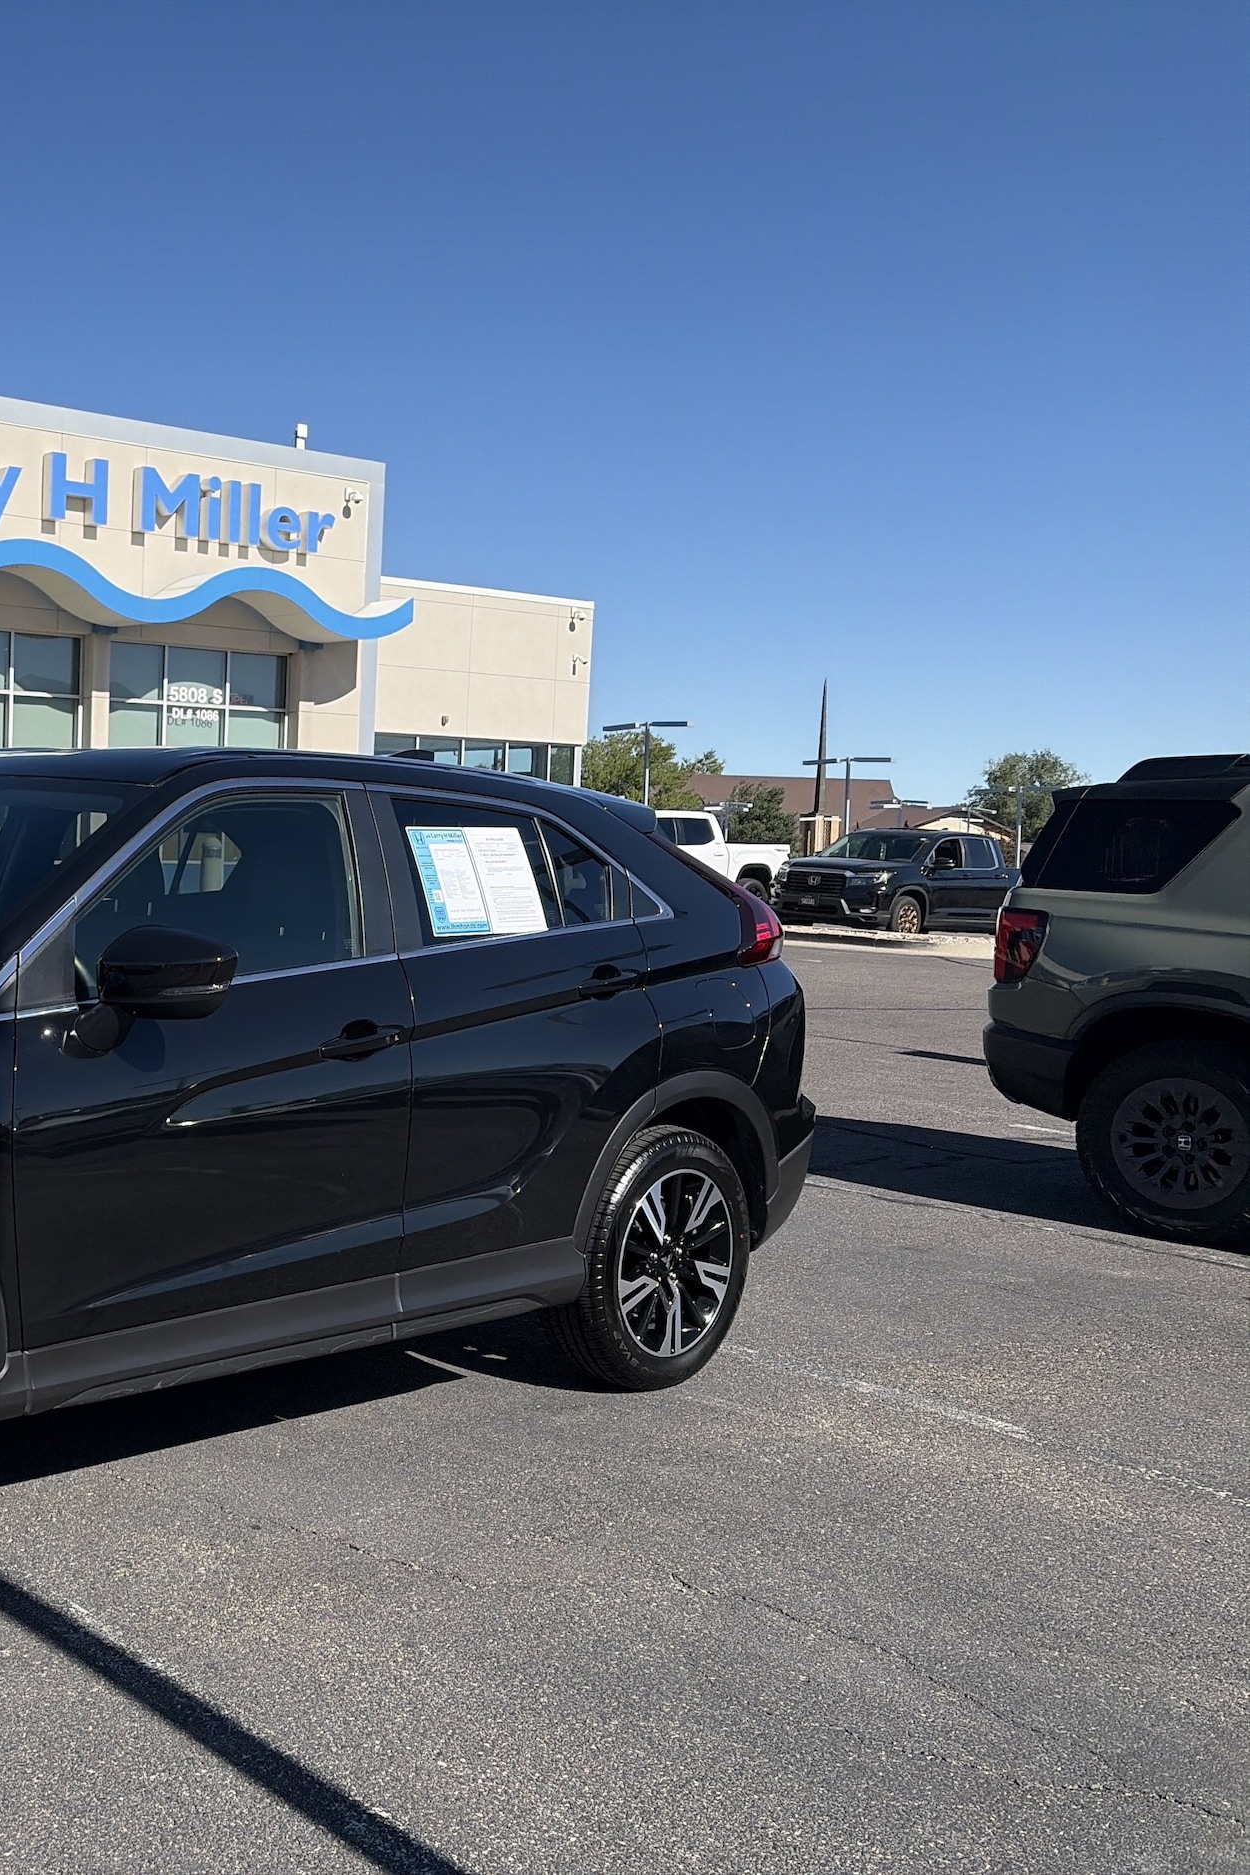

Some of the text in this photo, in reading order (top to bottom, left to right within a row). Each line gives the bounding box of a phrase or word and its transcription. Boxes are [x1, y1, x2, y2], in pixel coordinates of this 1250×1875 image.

[45, 451, 109, 526] H
[135, 465, 336, 554] Miller
[168, 685, 223, 705] 5808 S
[171, 707, 220, 722] DL# 1086
